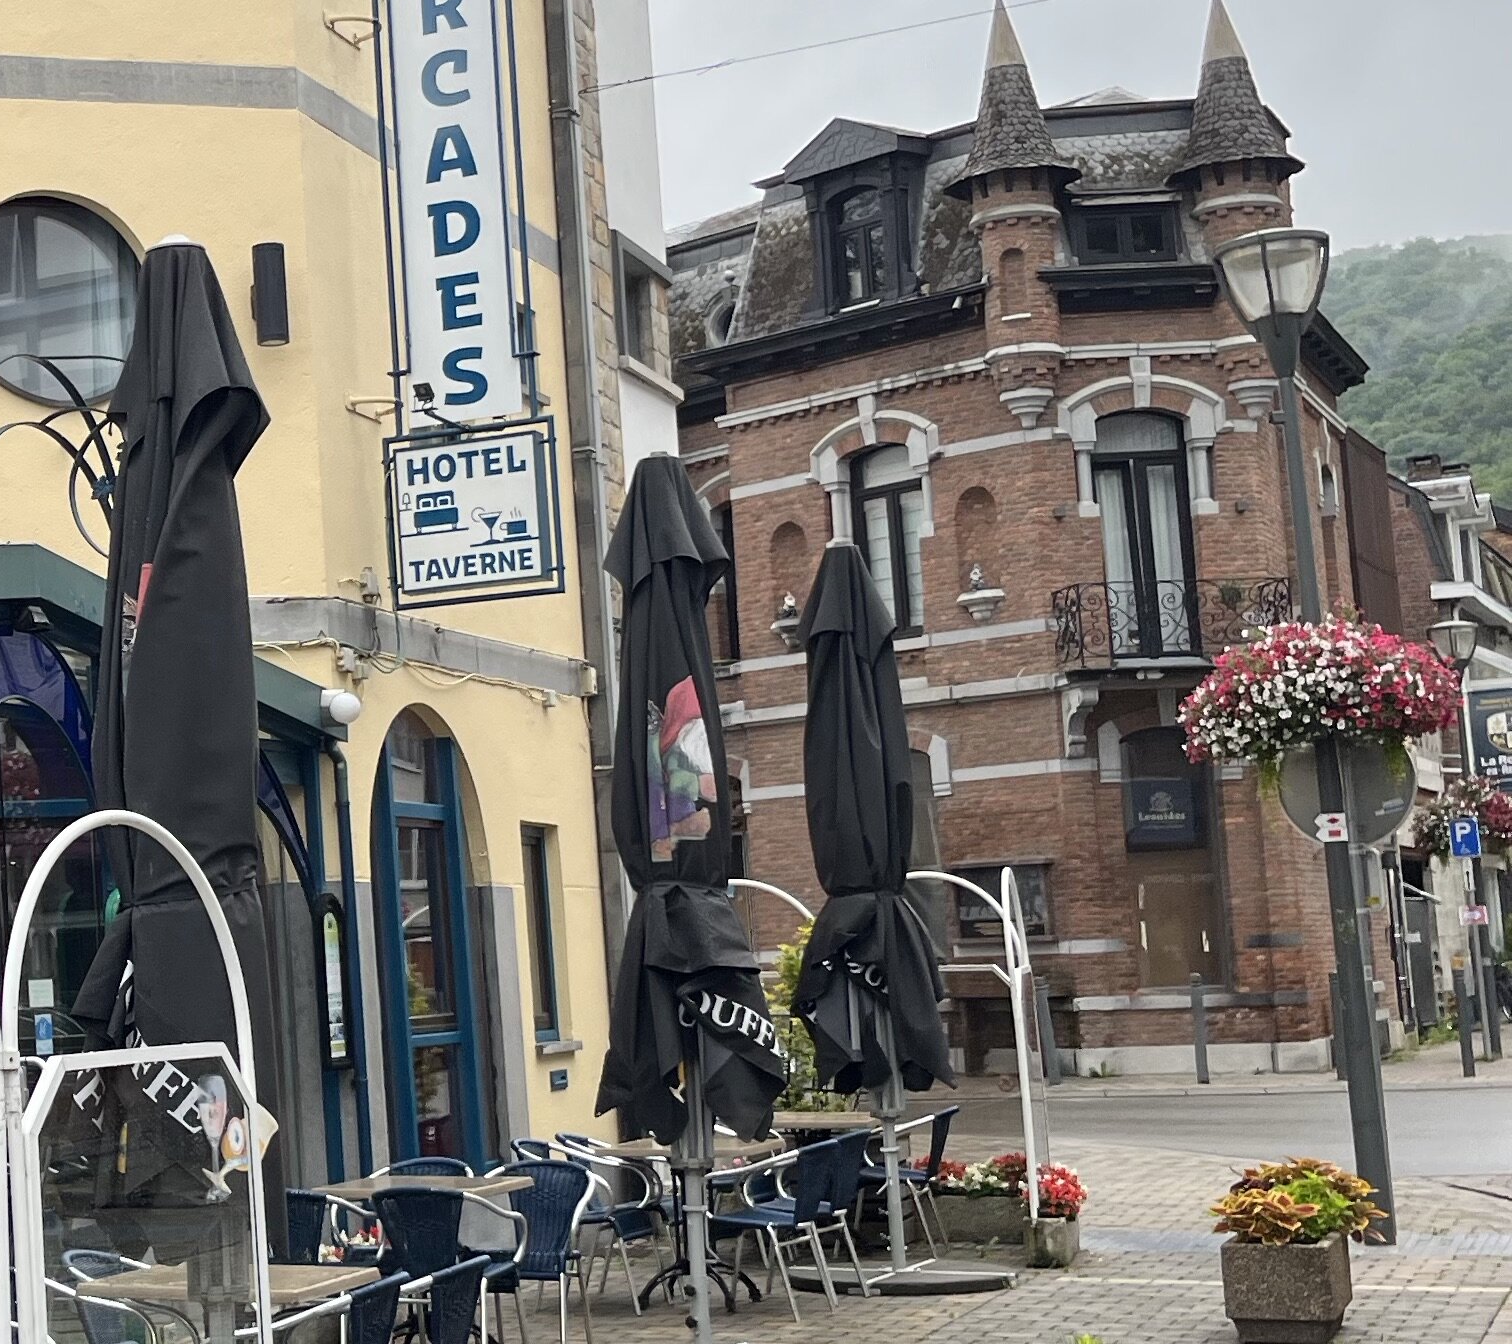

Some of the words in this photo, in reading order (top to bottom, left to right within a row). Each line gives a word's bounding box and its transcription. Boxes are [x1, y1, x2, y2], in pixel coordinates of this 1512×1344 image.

[406, 443, 527, 487] HOTEL
[408, 546, 535, 584] TAVERNE
[1455, 822, 1471, 843] P
